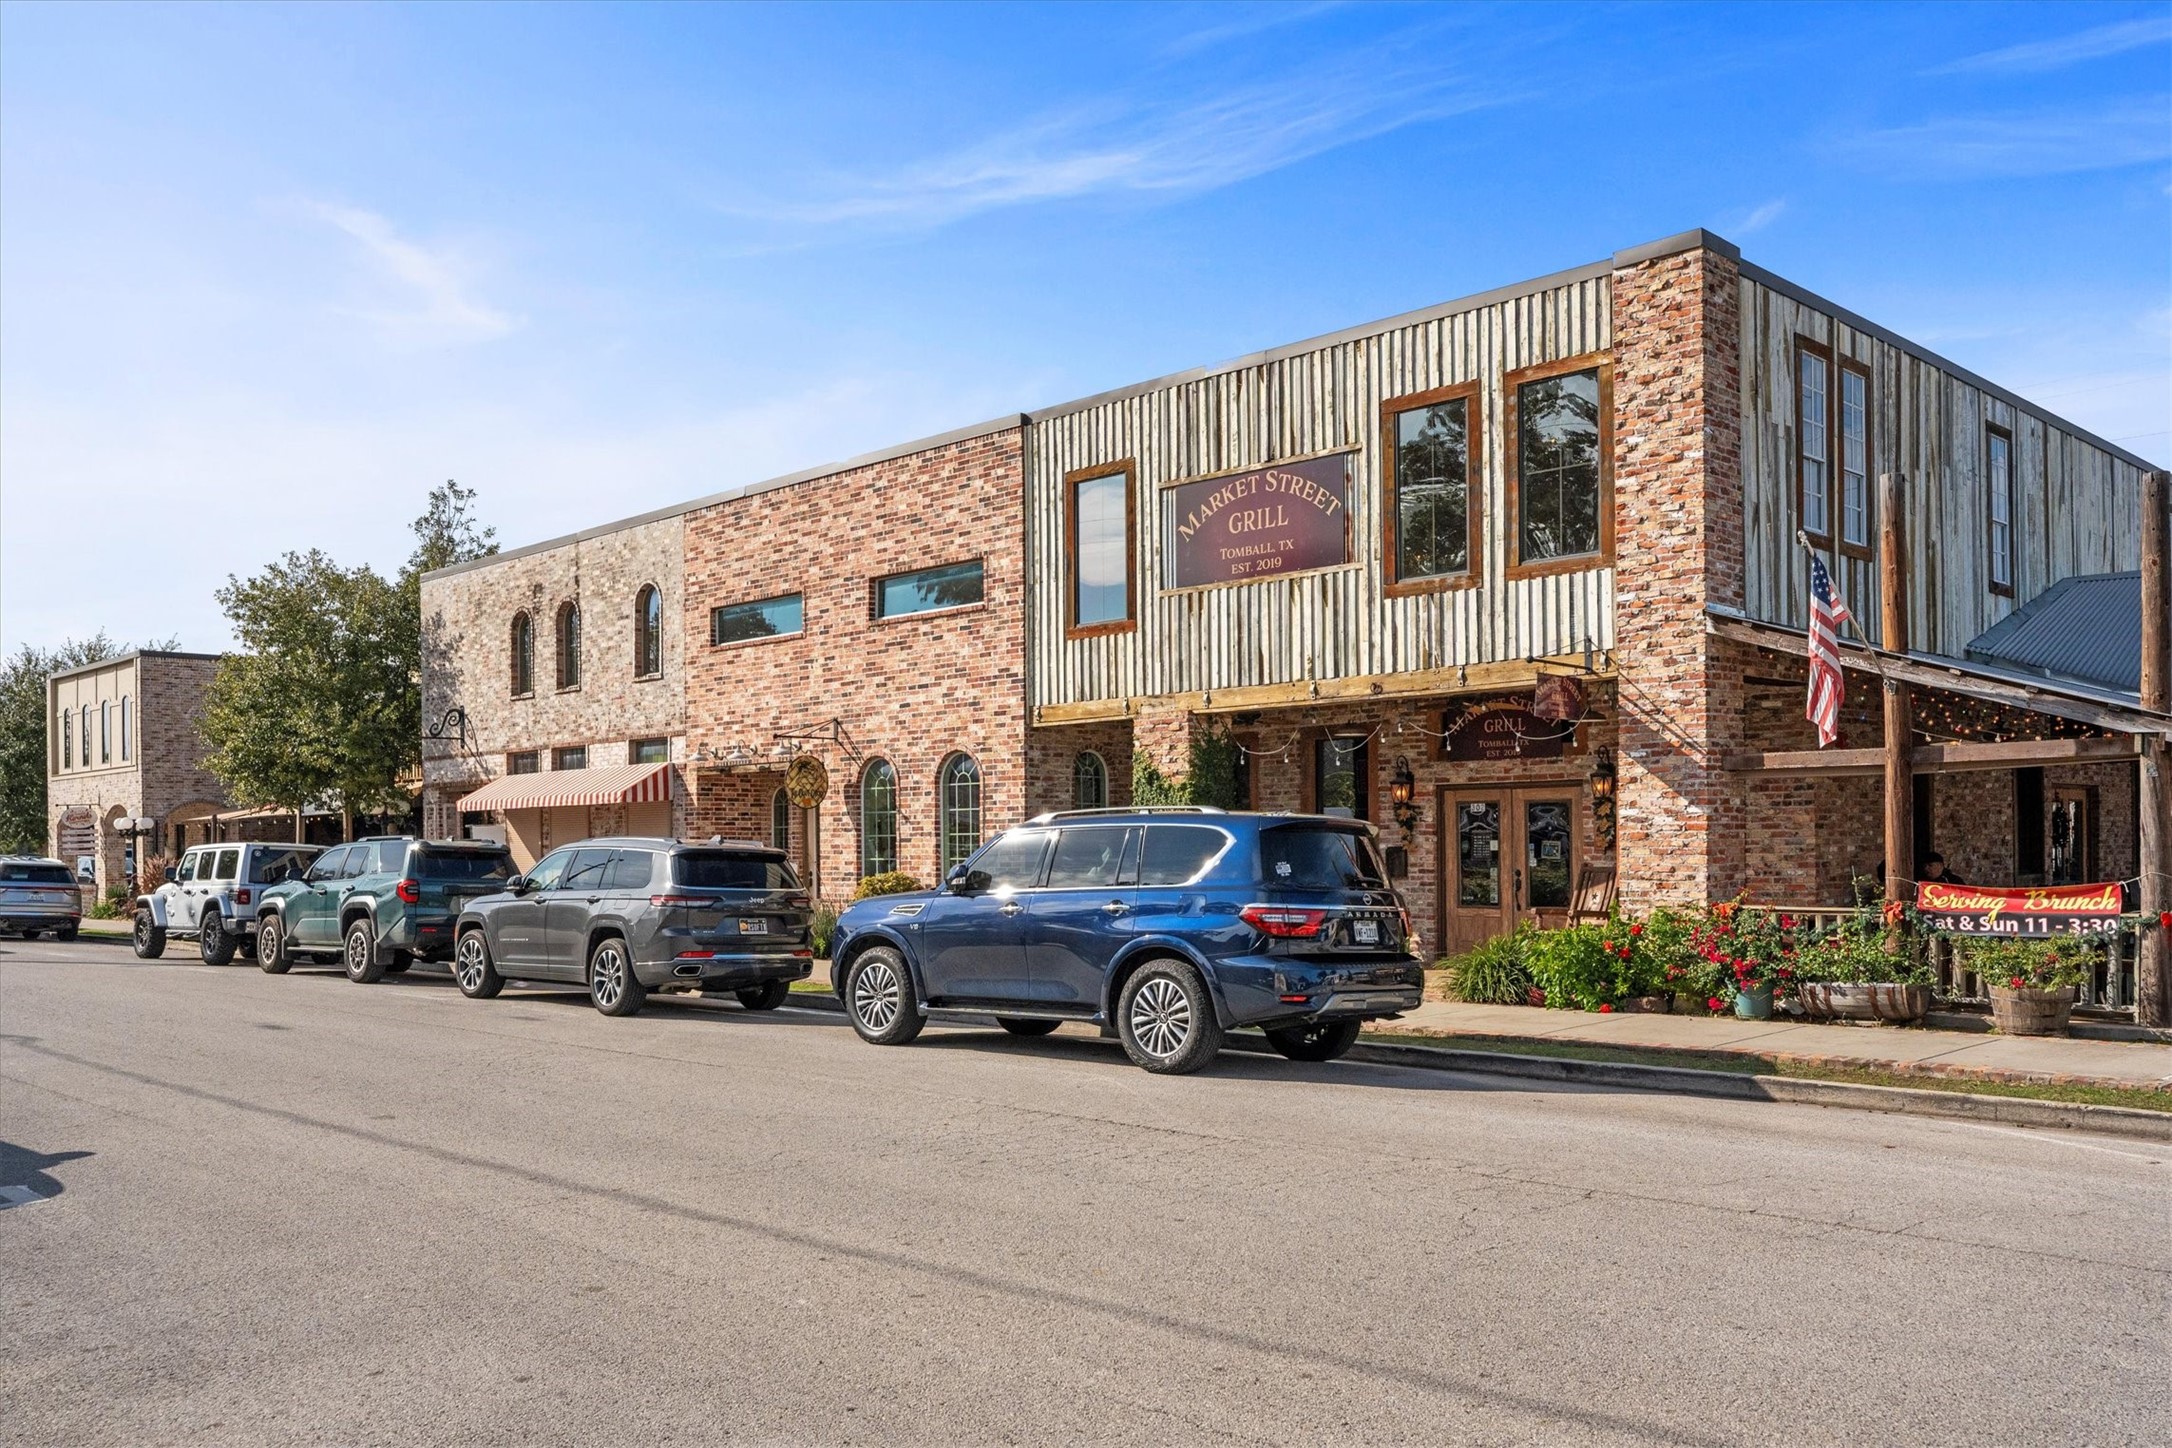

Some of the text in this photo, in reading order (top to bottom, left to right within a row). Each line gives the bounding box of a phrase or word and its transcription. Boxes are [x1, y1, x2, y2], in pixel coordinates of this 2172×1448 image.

[1177, 470, 1342, 543] MARKET STREET
[1228, 504, 1289, 534] GRILL
[1278, 539, 1294, 550] TX
[1231, 556, 1282, 574] EST. 2019
[1484, 717, 1526, 733] GRILL
[1922, 884, 2116, 925] Serving Brunch
[1922, 914, 1954, 931] Sat
[1959, 916, 1974, 931] &
[1979, 916, 2018, 932] Sun
[2025, 917, 2047, 933] 11
